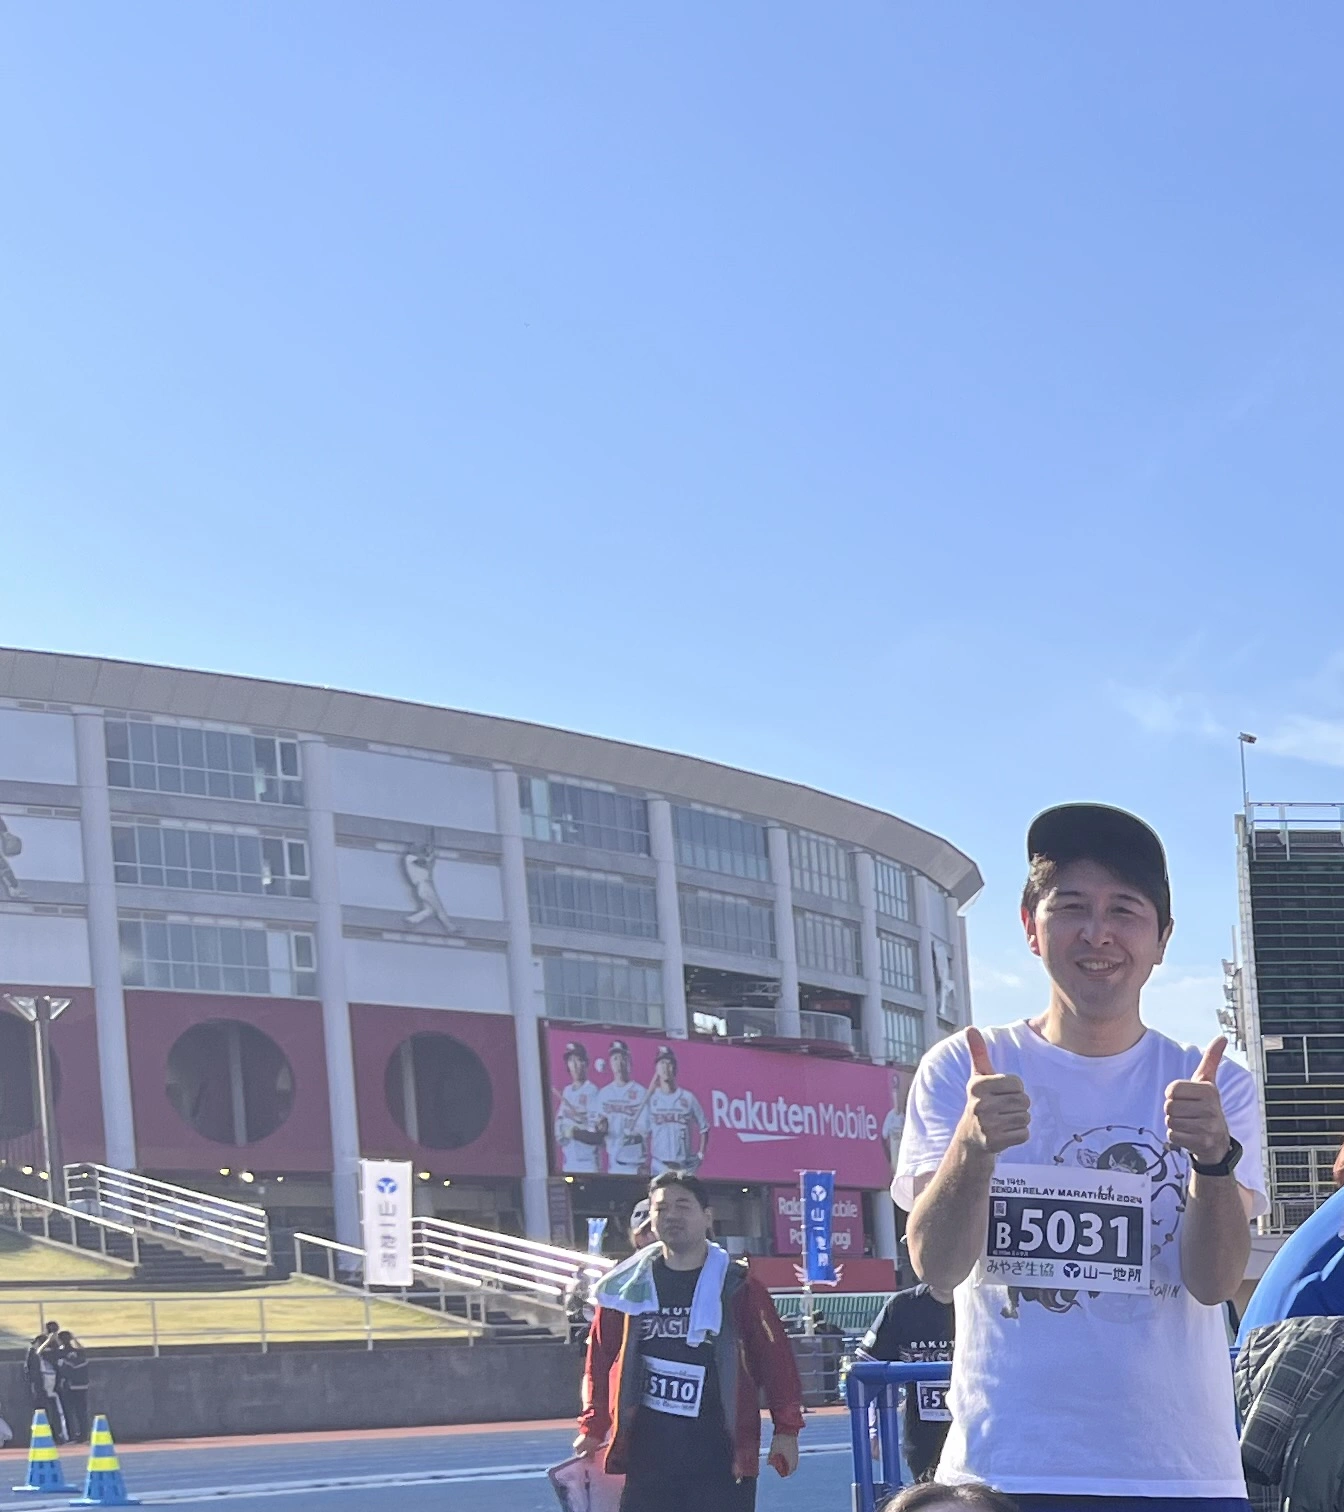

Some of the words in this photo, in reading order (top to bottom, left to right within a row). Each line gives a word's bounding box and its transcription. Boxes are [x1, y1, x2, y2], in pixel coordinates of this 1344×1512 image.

[711, 1090, 817, 1136] Rakuten
[819, 1101, 878, 1140] Mobile
[991, 1186, 1021, 1195] SENDAI
[1022, 1187, 1055, 1197] RELAY
[1058, 1188, 1115, 1201] MARATHON
[1116, 1196, 1143, 1204] 2024
[831, 1200, 858, 1218] obile
[995, 1222, 1012, 1249] B
[1018, 1208, 1129, 1258] 5031
[986, 1259, 1055, 1278] みやぎ生協
[1083, 1265, 1142, 1283] 山一地所
[911, 1341, 955, 1349] RAKU
[650, 1376, 696, 1400] 5110
